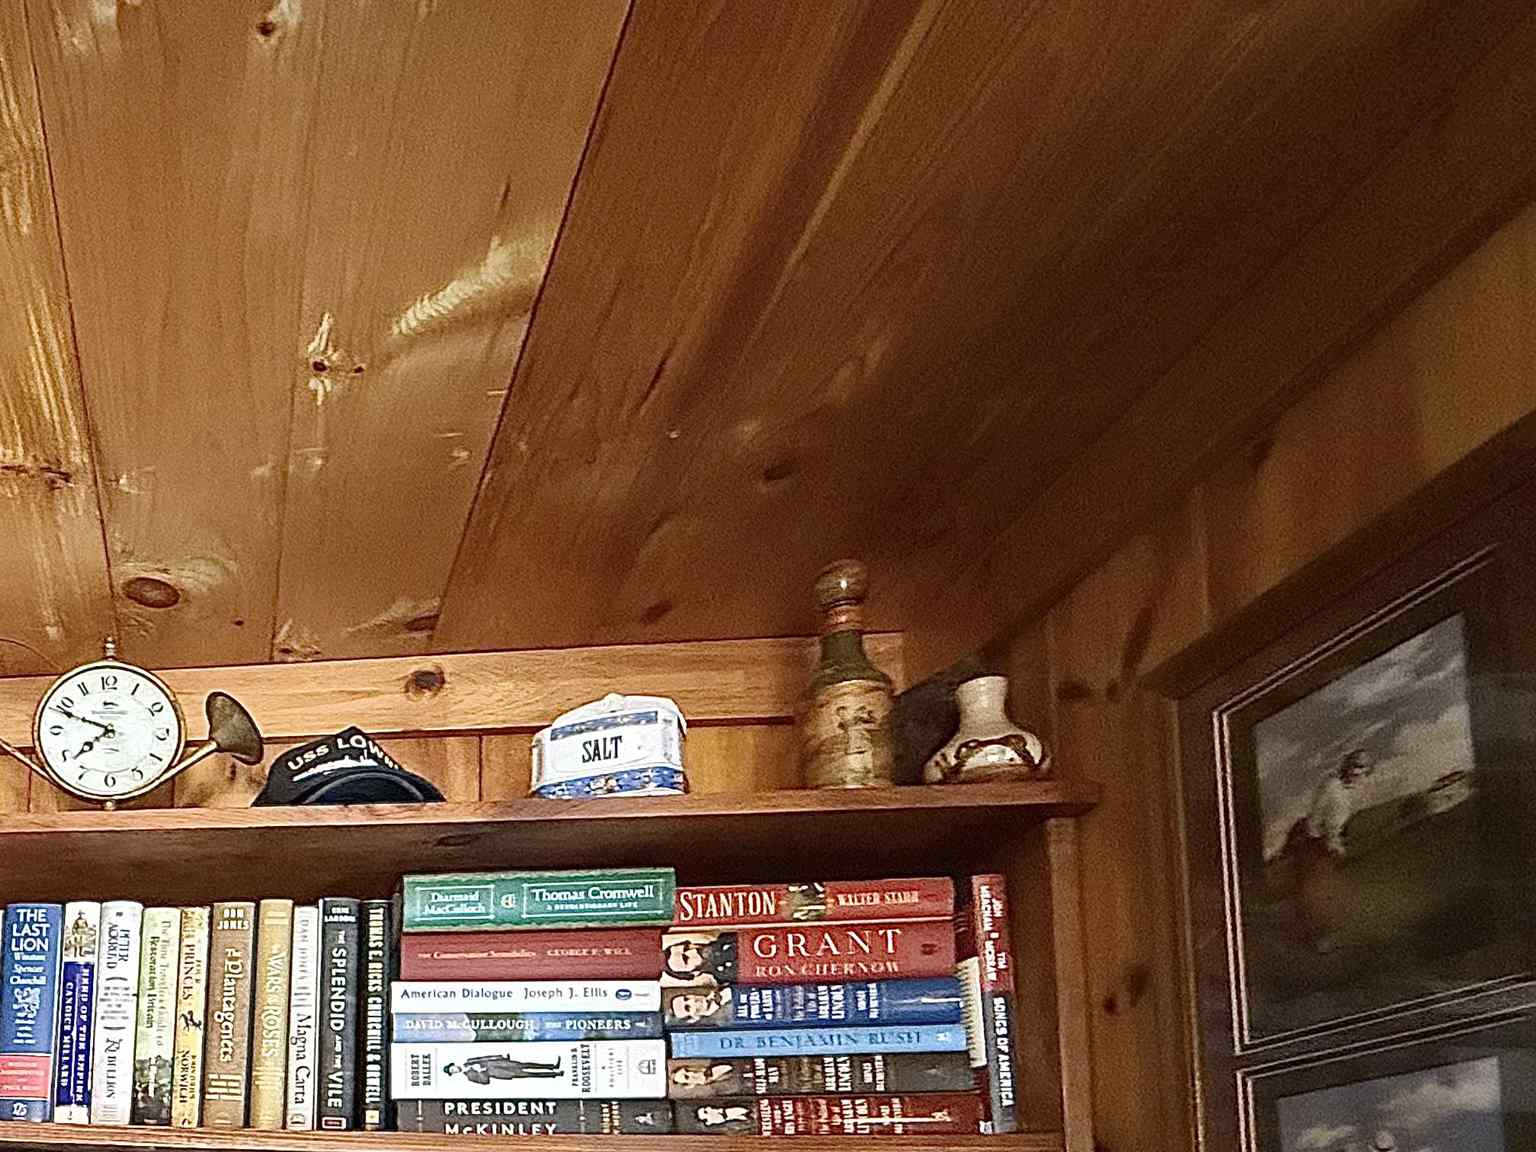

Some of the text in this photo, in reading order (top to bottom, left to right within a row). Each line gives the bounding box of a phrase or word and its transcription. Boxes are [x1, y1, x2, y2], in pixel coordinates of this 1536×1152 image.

[101, 675, 118, 690] 12
[287, 745, 329, 770] USS
[581, 735, 623, 763] SALT
[531, 884, 654, 902] Thomas Cromwell
[16, 909, 47, 922] THE
[679, 890, 775, 922] STANTON
[13, 923, 50, 937] LAST
[11, 938, 49, 951] LION
[753, 929, 902, 958] GRANT
[183, 943, 196, 1000] PRINCES
[755, 961, 900, 978] RON CHERNOW
[365, 908, 384, 1104] THOMAS RICKS CHURCHILL ORWELL
[400, 987, 608, 1001] American Dialogue Joseph J. Ellis
[215, 960, 243, 1062] Plantagenets
[60, 982, 74, 1087] CANDICE MILLARD
[327, 947, 346, 1108] SPLENDID VILE
[405, 1019, 631, 1030] DAVID PIONEERS
[757, 1031, 921, 1049] BENJAMIN RUSH
[993, 997, 1013, 1106] SONGS OF AMERICA
[291, 1013, 312, 1104] Magna Carta
[581, 1044, 591, 1093] ROOSEVELT
[443, 1101, 557, 1115] PRESIDENT
[444, 1123, 557, 1135] McKINLEY
